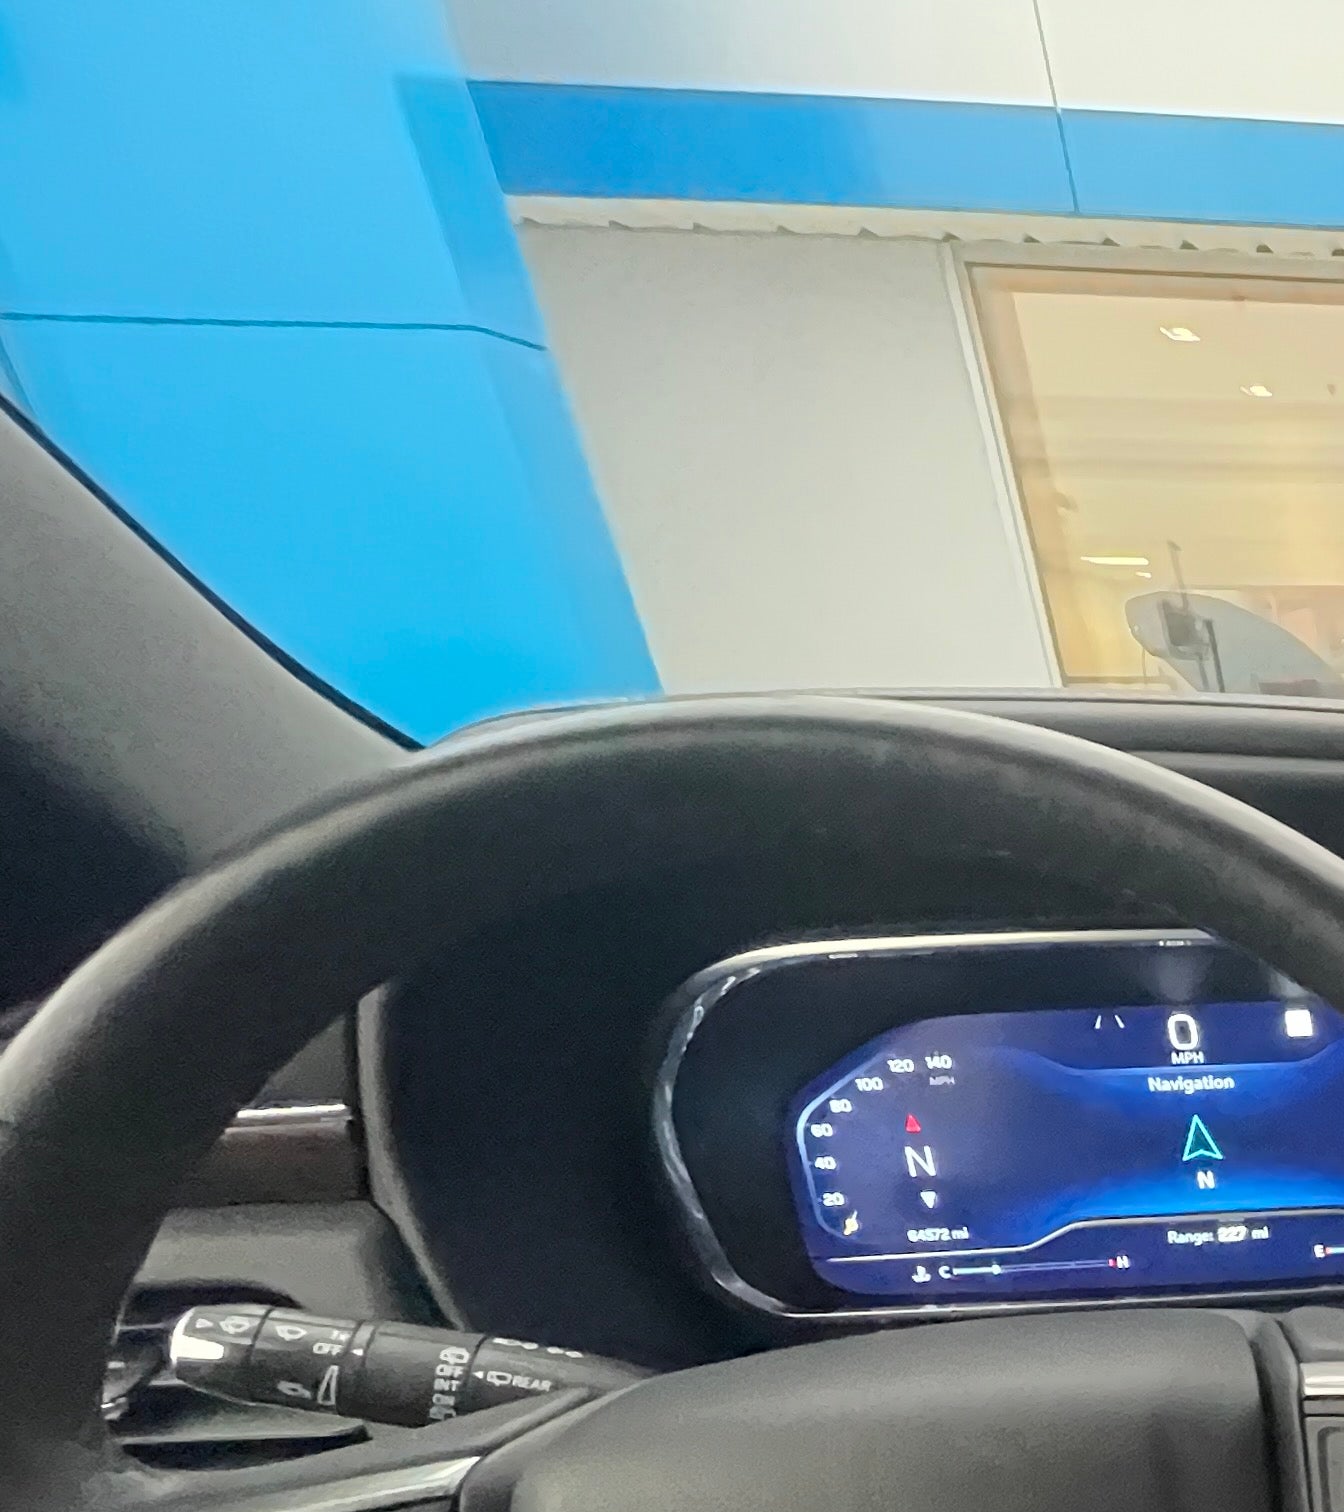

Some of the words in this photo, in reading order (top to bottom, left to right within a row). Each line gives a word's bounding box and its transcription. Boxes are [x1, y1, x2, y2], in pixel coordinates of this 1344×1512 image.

[887, 1058, 915, 1073] 120
[924, 1054, 953, 1070] 140
[1171, 1051, 1205, 1066] MPH
[855, 1076, 884, 1092] 100
[1147, 1074, 1236, 1096] Navigation
[904, 1145, 937, 1178] N
[1196, 1170, 1216, 1190] N
[434, 1362, 464, 1378] OFF
[433, 1378, 462, 1393] INT
[511, 1374, 552, 1393] REAR
